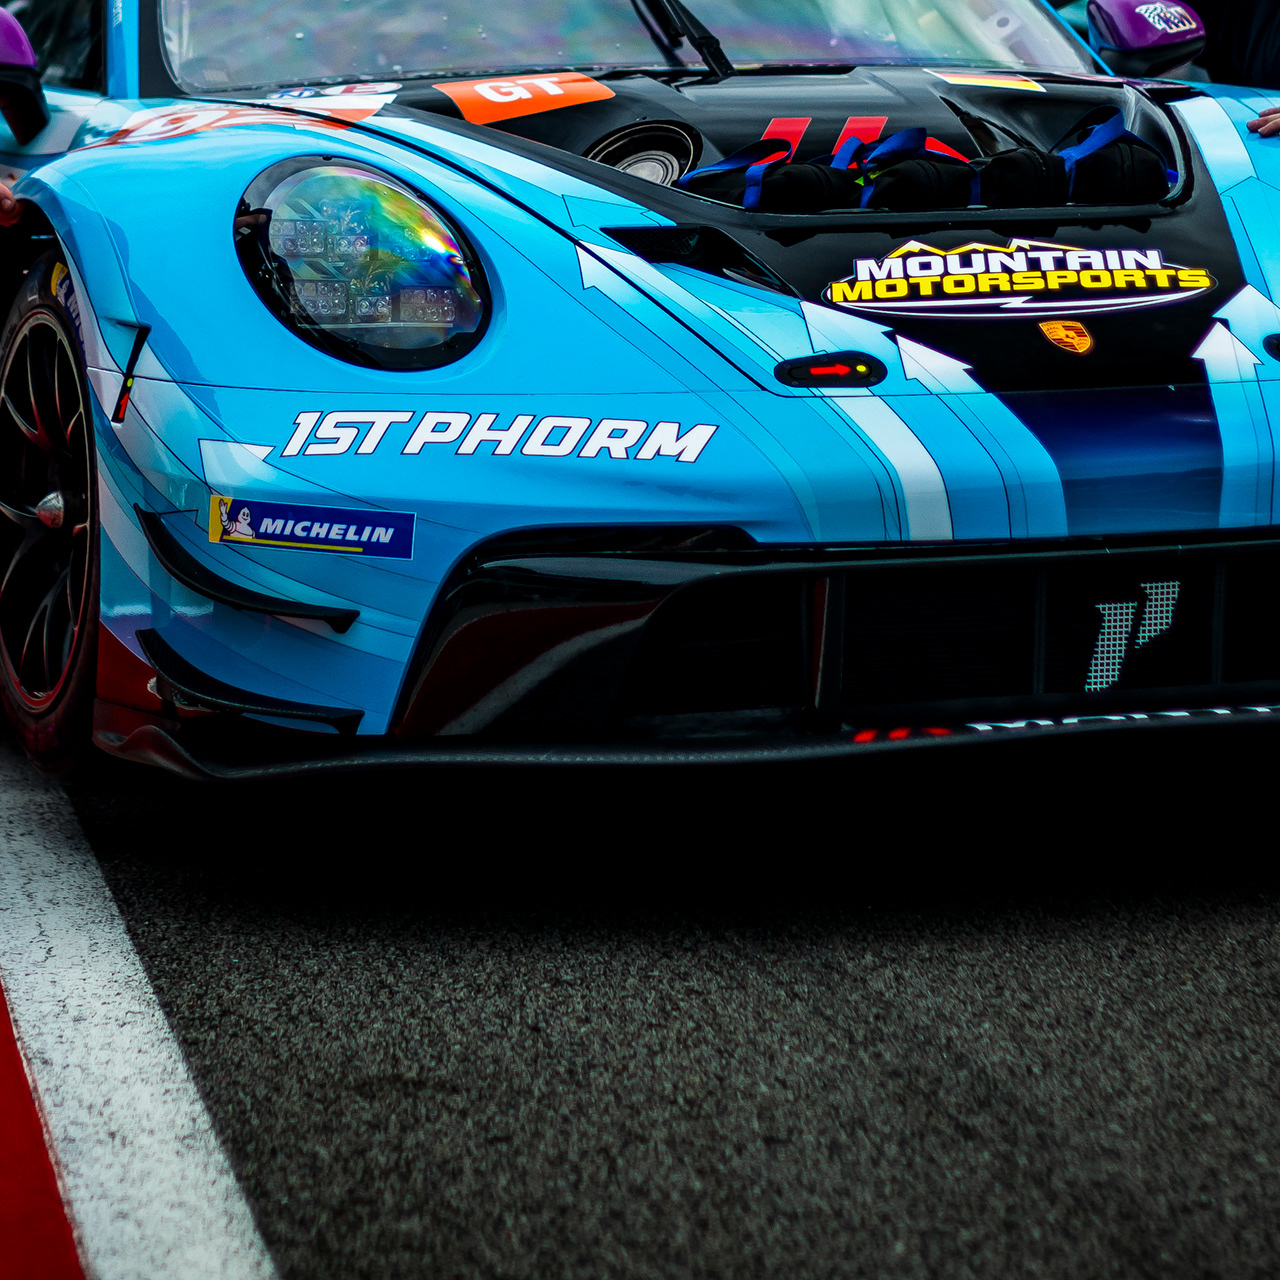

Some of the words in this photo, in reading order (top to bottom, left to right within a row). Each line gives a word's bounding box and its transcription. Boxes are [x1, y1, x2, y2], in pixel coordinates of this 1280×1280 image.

[473, 77, 565, 103] GT
[855, 249, 1163, 281] MOUNTAIN
[831, 268, 1211, 303] MOTORSPORTS
[281, 410, 416, 458] 1ST
[401, 410, 718, 463] PHORM
[258, 516, 395, 545] MICHELIN
